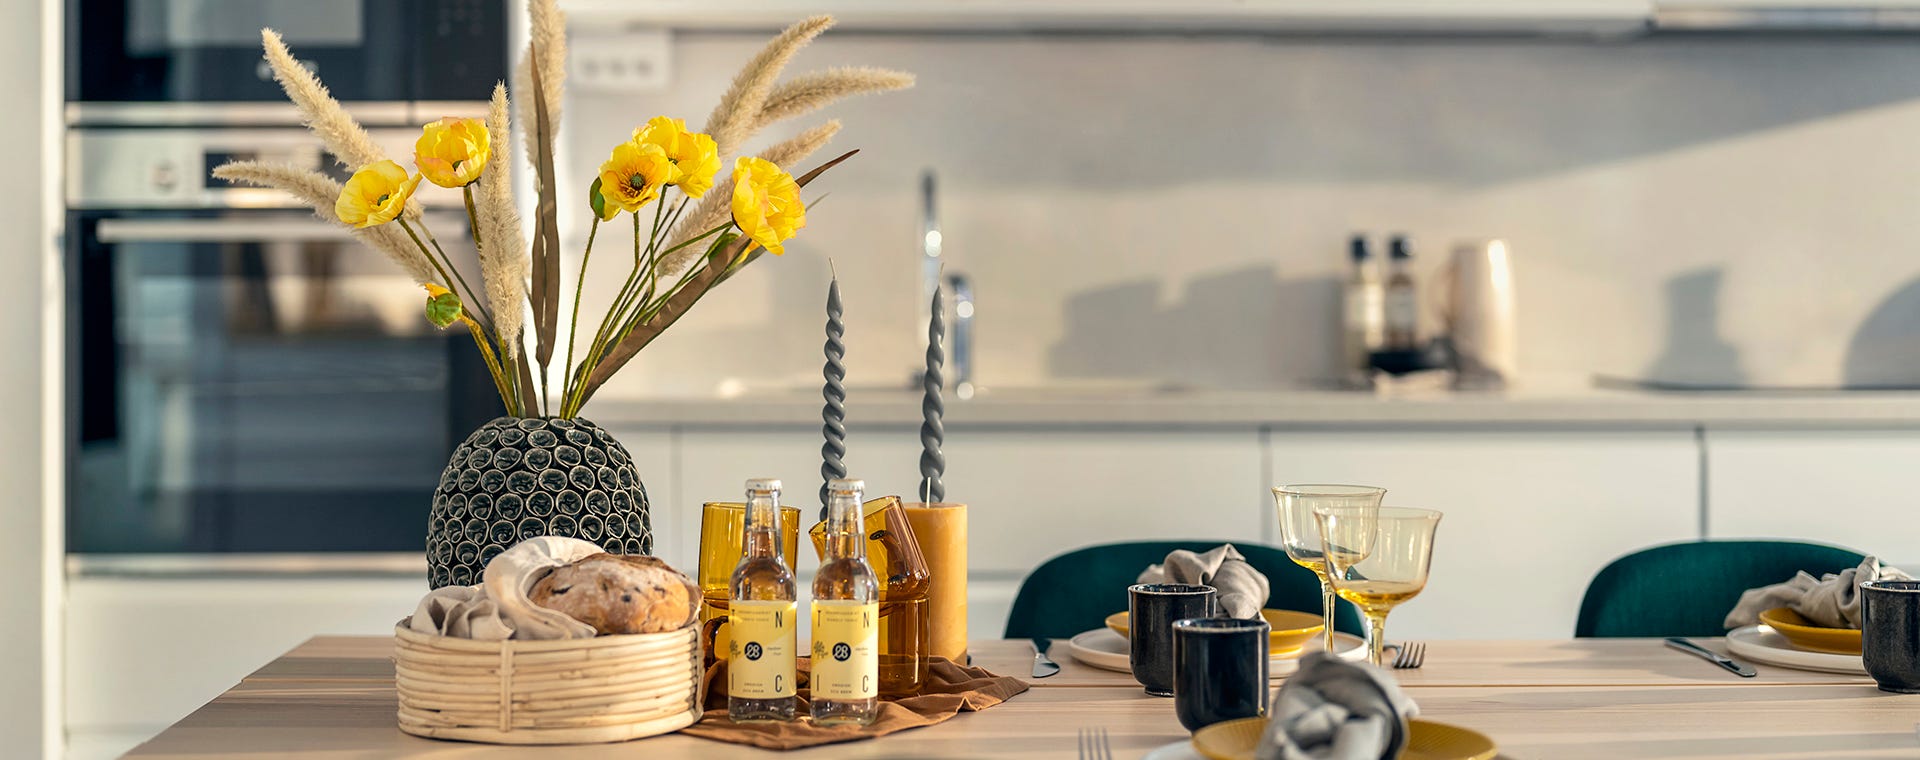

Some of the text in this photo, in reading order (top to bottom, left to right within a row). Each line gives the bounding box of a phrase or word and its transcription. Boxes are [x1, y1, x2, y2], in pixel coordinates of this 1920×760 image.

[775, 610, 783, 628] N
[863, 611, 869, 629] N
[775, 674, 783, 693] C
[862, 674, 869, 693] C
